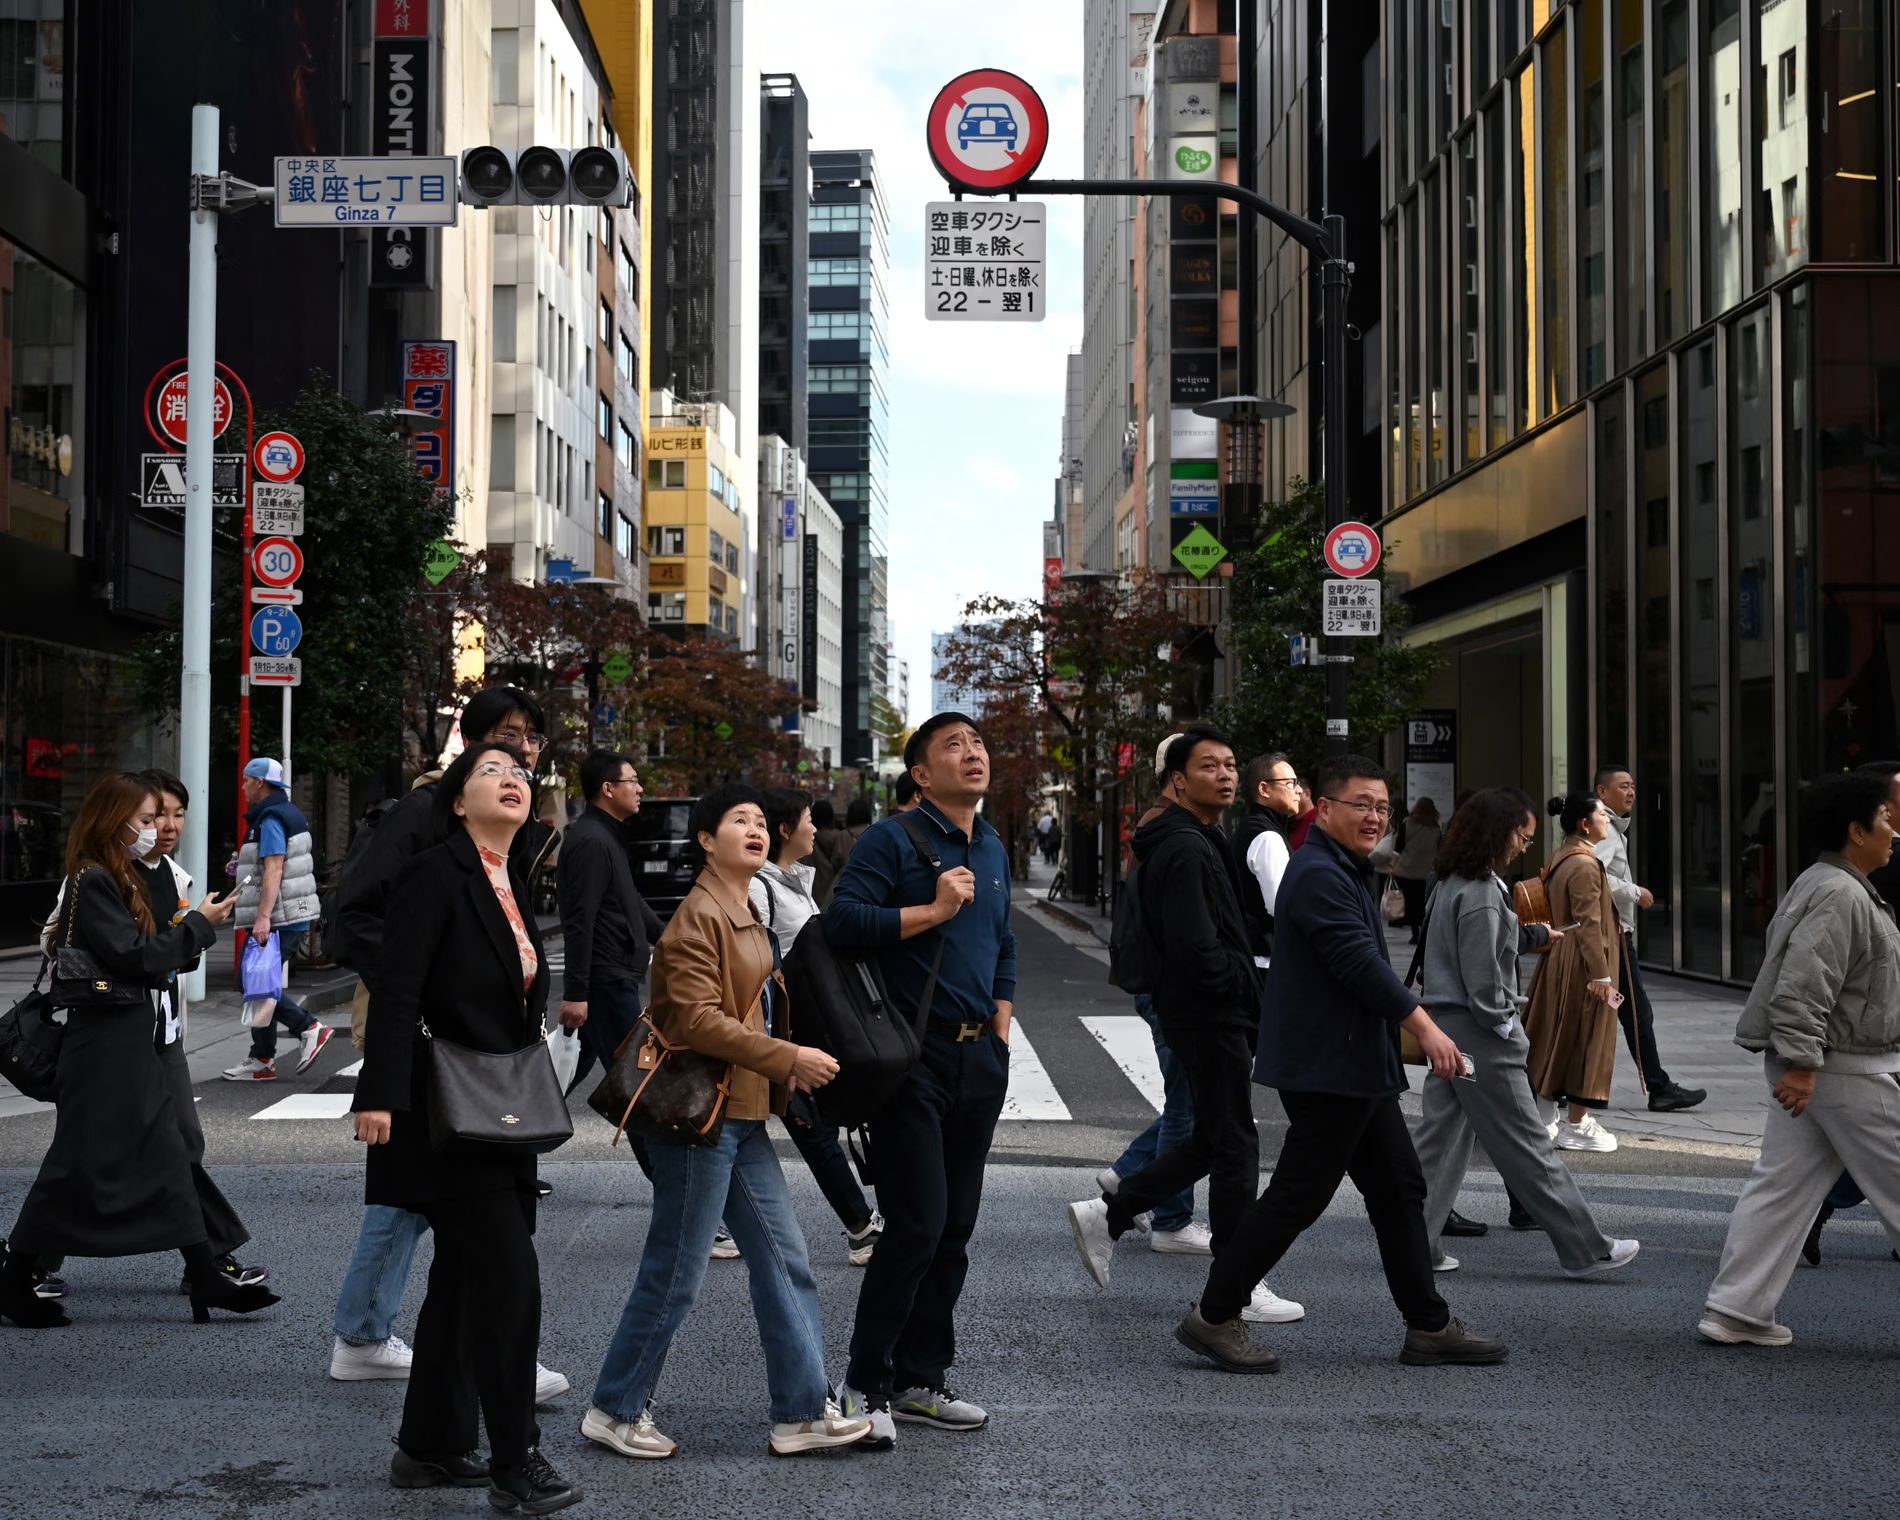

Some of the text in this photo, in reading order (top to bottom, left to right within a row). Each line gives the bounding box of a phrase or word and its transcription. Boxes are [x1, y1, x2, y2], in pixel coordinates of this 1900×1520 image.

[287, 159, 337, 174] 中央区
[287, 174, 445, 203] 銀座七丁目
[335, 205, 397, 221] Ginza 7
[931, 211, 1041, 231] 空車タクシー
[930, 235, 1025, 256] 迎車を除く
[408, 344, 449, 377] 薬
[256, 487, 301, 498] 空車タクシー
[1171, 483, 1217, 493] FamilyMart
[1181, 545, 1220, 556] 花椿通り
[264, 550, 292, 573] 30
[1327, 584, 1376, 596] 空車タクシー
[1327, 595, 1374, 607] 迎車を除く
[262, 619, 282, 650] P
